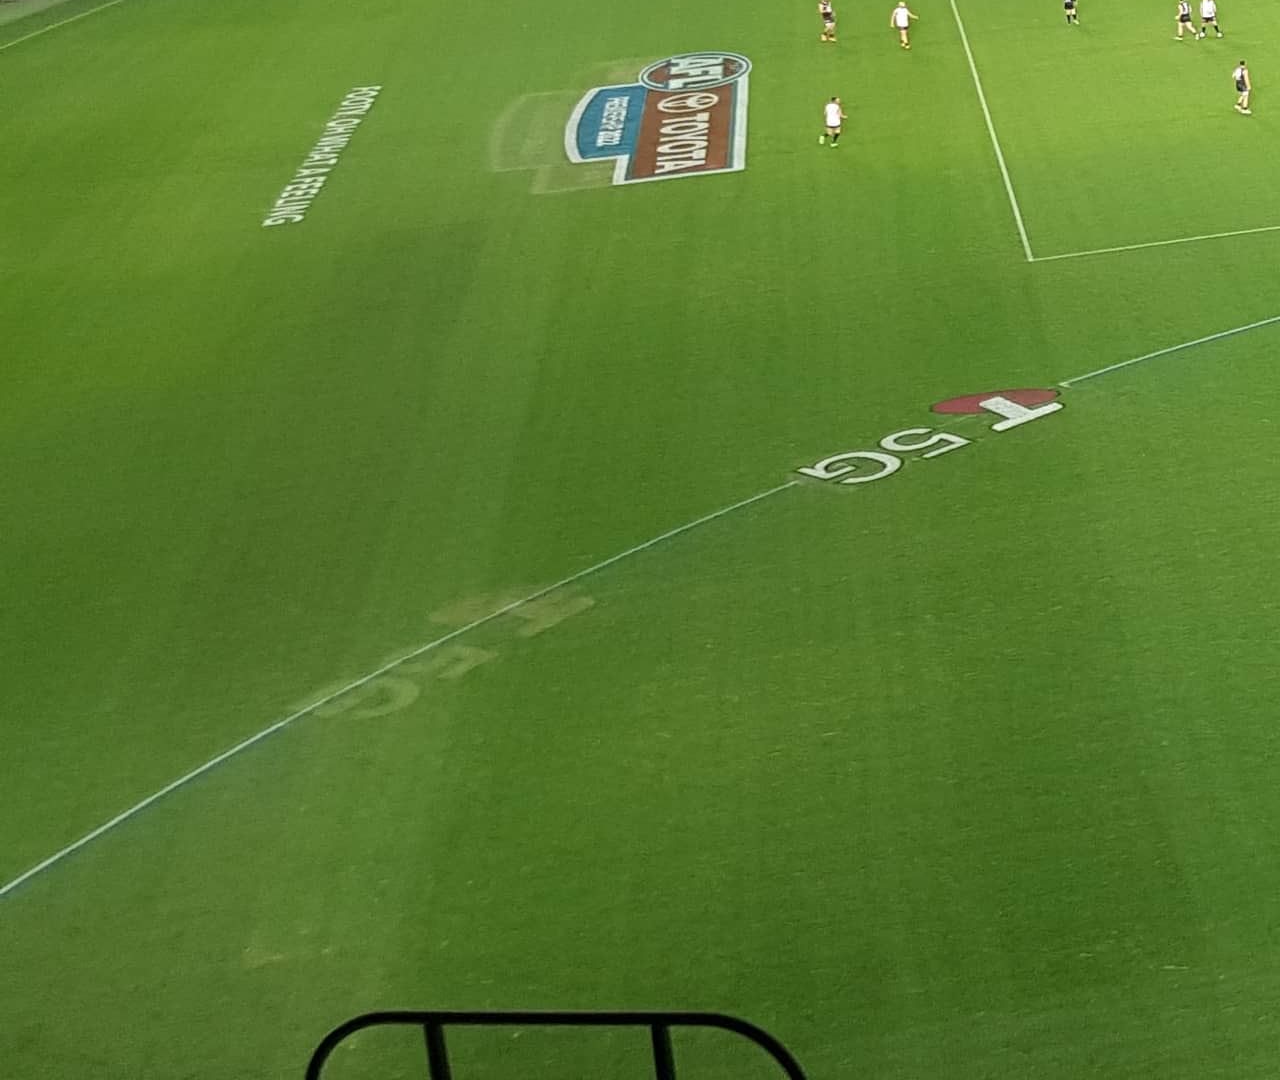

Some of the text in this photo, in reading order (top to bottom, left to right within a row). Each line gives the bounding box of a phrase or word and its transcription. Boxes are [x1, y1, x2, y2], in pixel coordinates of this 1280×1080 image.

[667, 56, 724, 90] AFL
[322, 118, 362, 136] OH
[654, 111, 710, 174] TOYOTA
[303, 133, 353, 167] WHAT
[295, 167, 332, 178] A
[261, 175, 328, 227] FEELING
[797, 427, 973, 485] 5G
